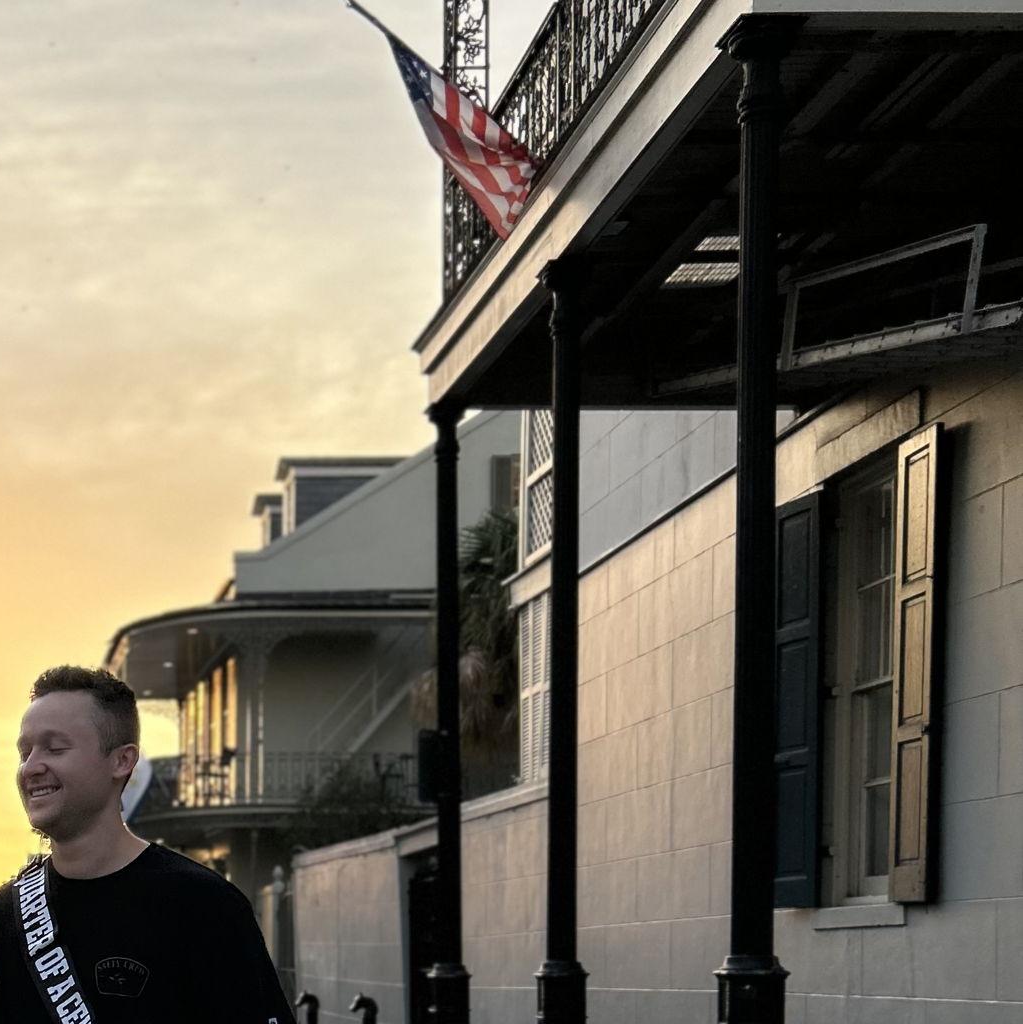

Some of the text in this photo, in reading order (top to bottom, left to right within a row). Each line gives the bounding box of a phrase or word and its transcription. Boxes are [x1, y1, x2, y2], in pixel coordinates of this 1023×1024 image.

[14, 866, 55, 957] QUARTER
[35, 947, 69, 980] OF
[47, 975, 75, 1002] A
